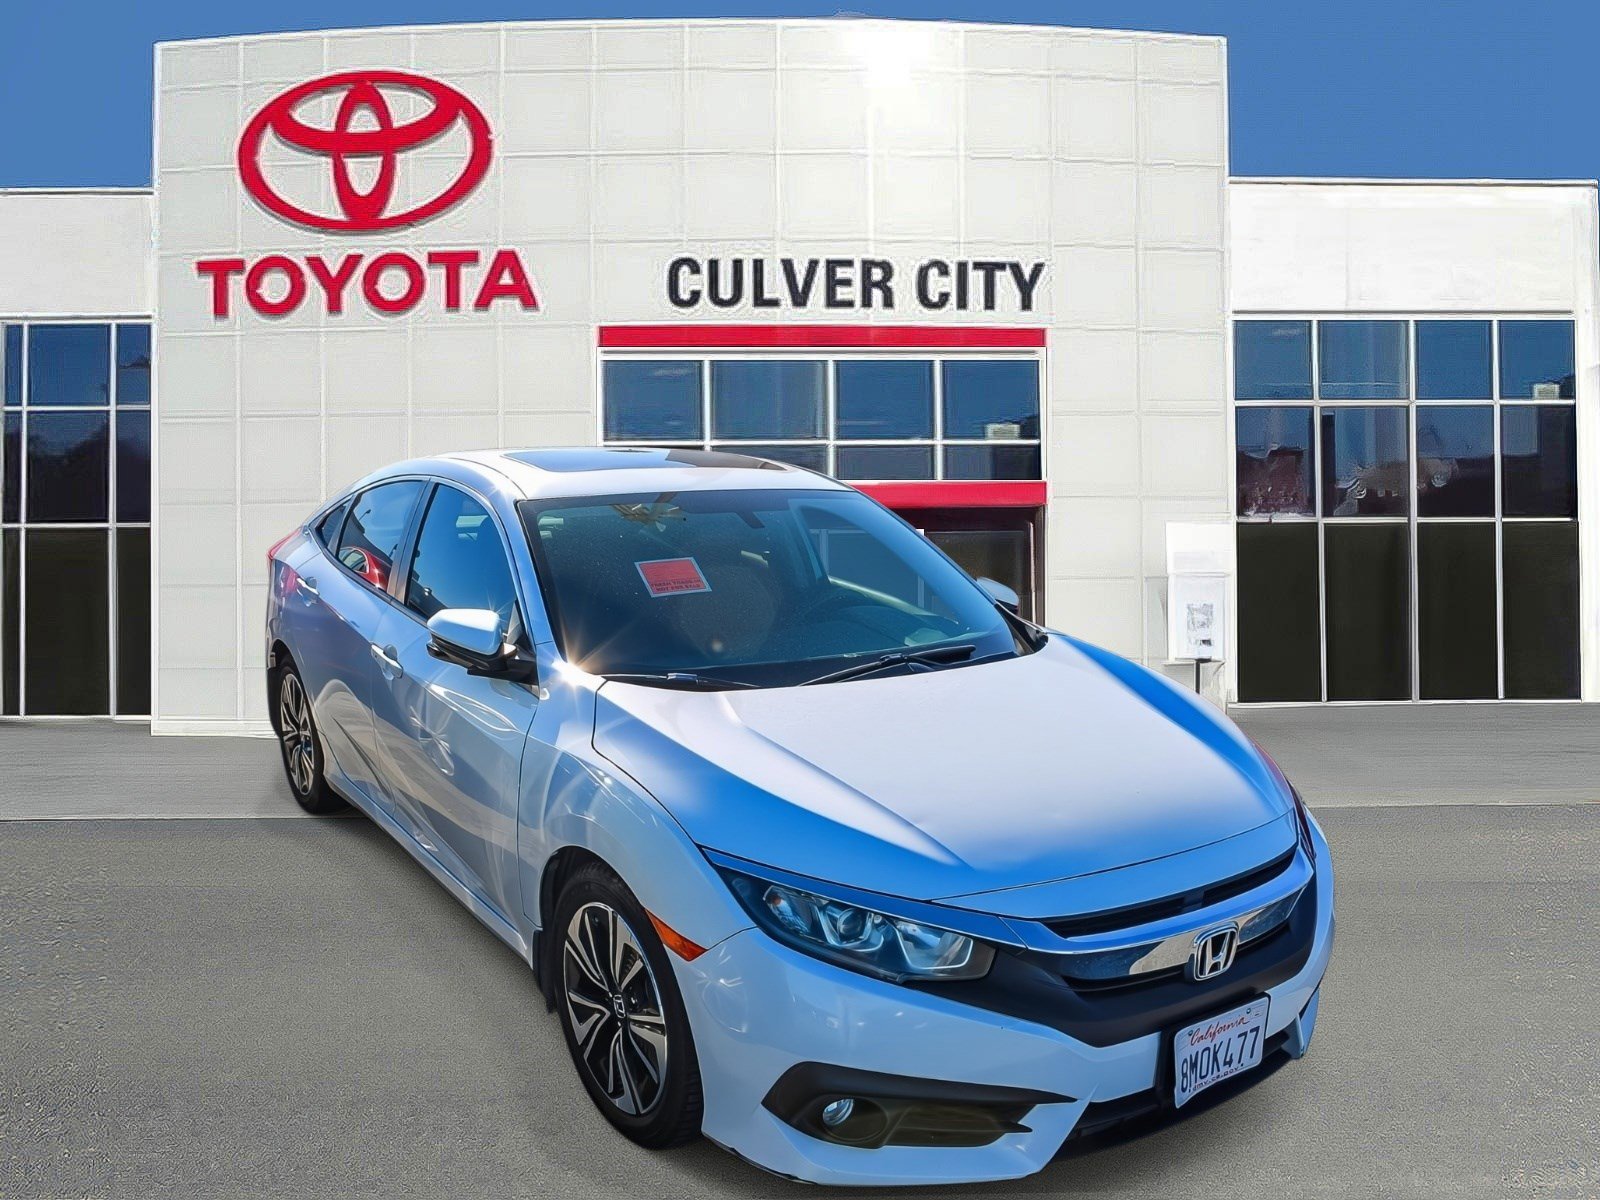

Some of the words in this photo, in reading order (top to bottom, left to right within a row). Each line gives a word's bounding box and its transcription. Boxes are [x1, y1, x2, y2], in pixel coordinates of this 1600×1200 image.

[196, 250, 538, 317] TOYOTA
[669, 257, 894, 310] CULVER
[916, 257, 1045, 311] CITY
[1181, 1025, 1261, 1093] 8MOK477
[1190, 1015, 1250, 1046] California
